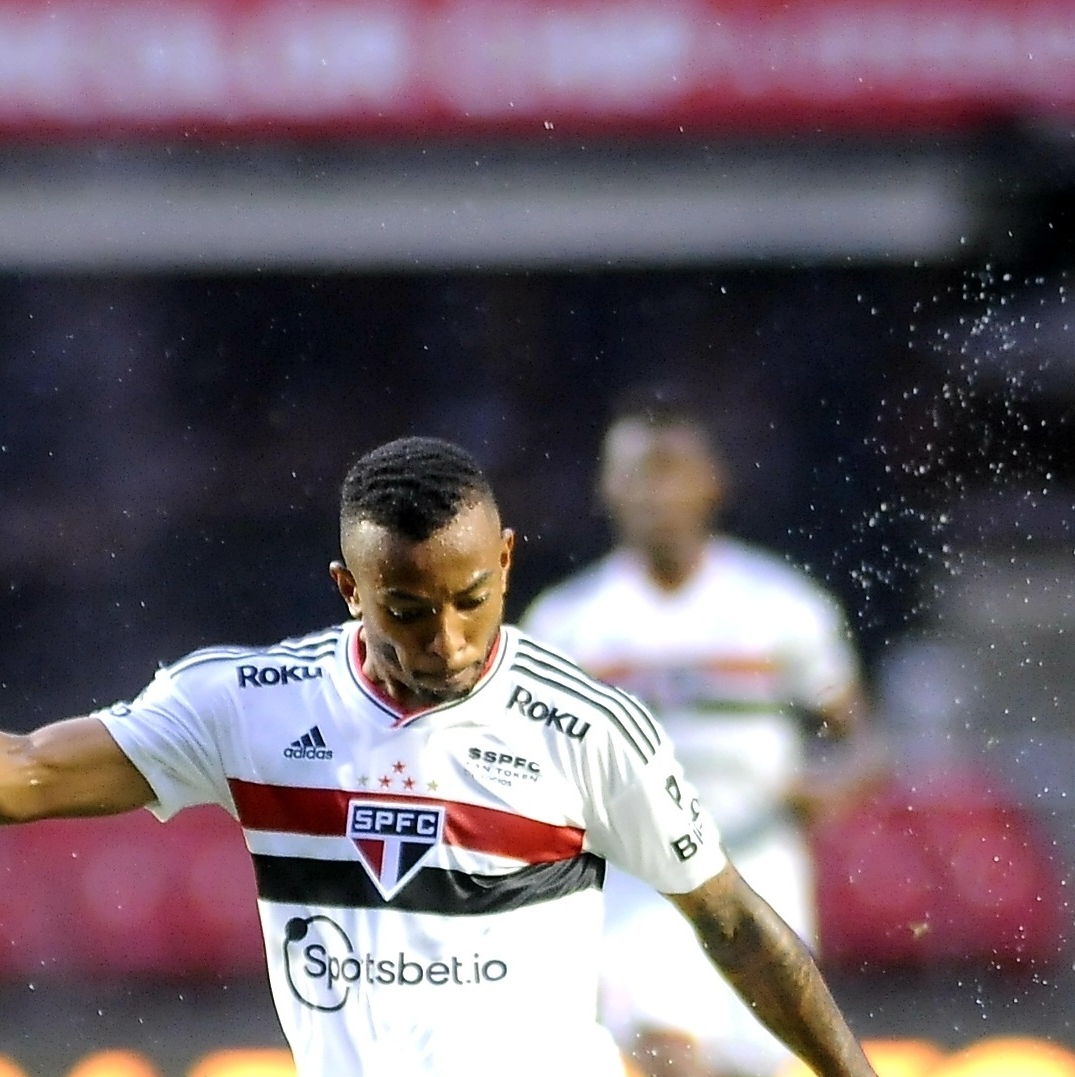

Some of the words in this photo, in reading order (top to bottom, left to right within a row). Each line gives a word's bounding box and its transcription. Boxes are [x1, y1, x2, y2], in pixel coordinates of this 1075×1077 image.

[283, 746, 333, 760] adidas
[353, 808, 436, 836] SPFC
[304, 944, 508, 990] Spotsbet.io
